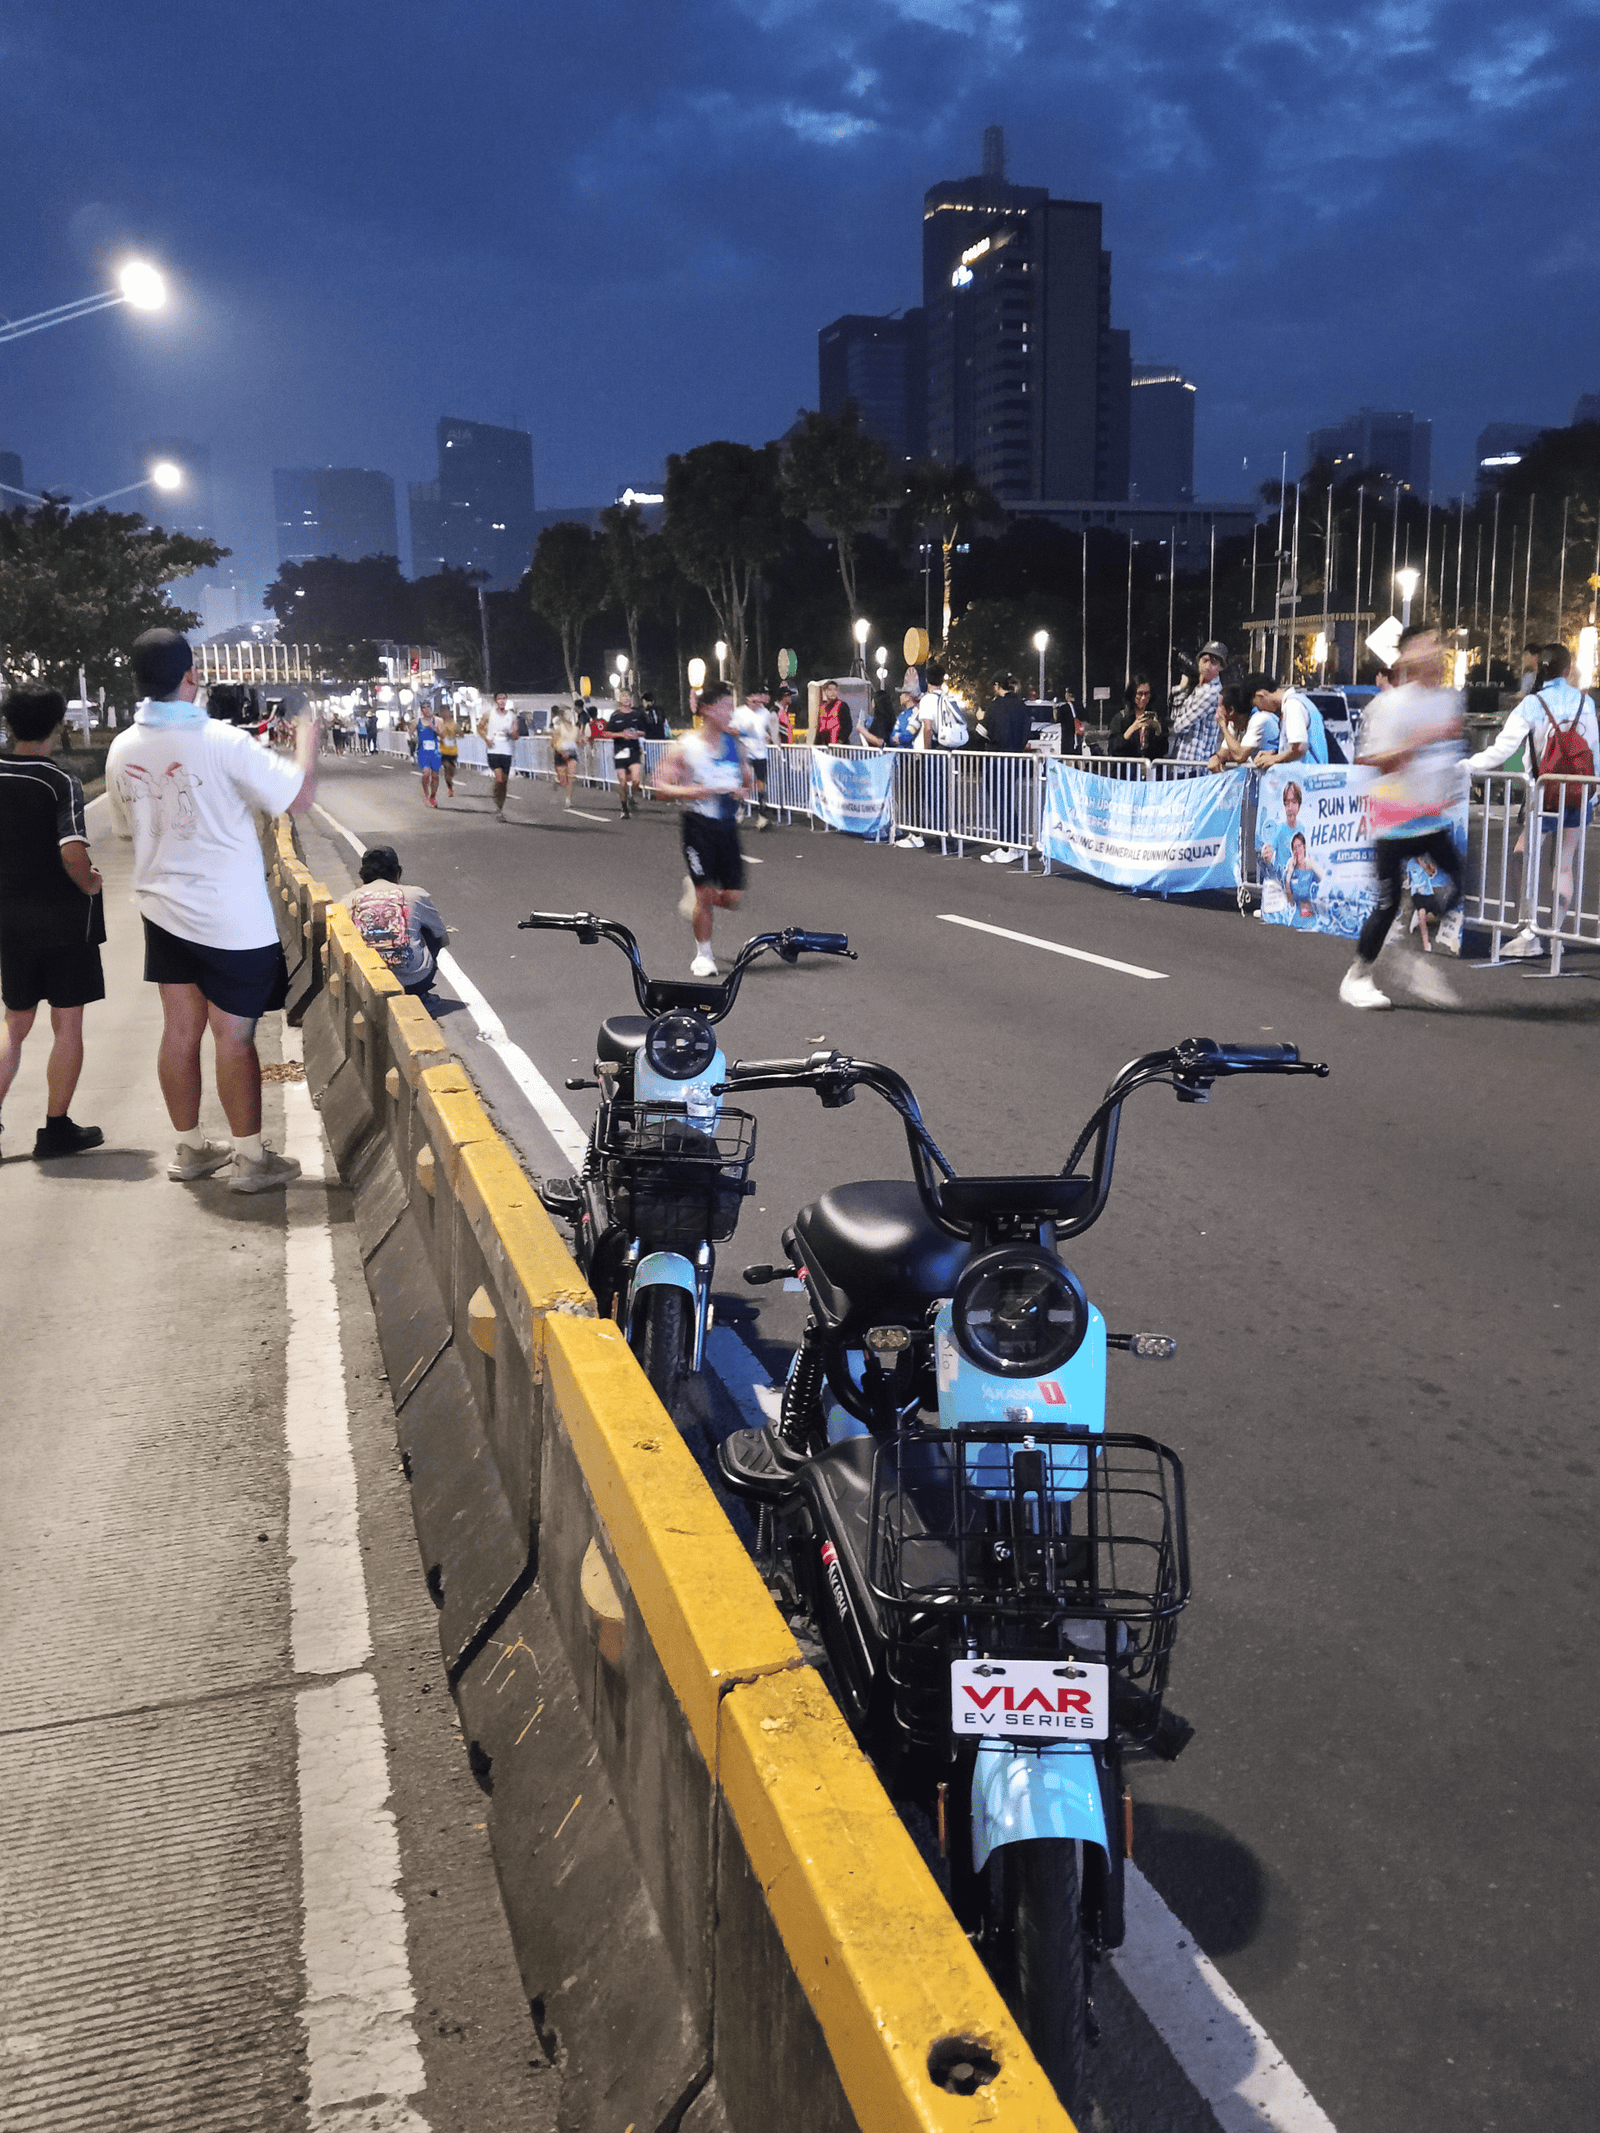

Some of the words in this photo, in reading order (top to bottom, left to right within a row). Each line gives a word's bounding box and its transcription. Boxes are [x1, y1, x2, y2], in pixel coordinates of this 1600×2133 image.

[1318, 797, 1344, 818] RUN
[1311, 821, 1355, 847] HEART
[961, 1685, 1093, 1714] VIAR
[964, 1712, 996, 1724] EV
[1006, 1714, 1094, 1729] SERIES
